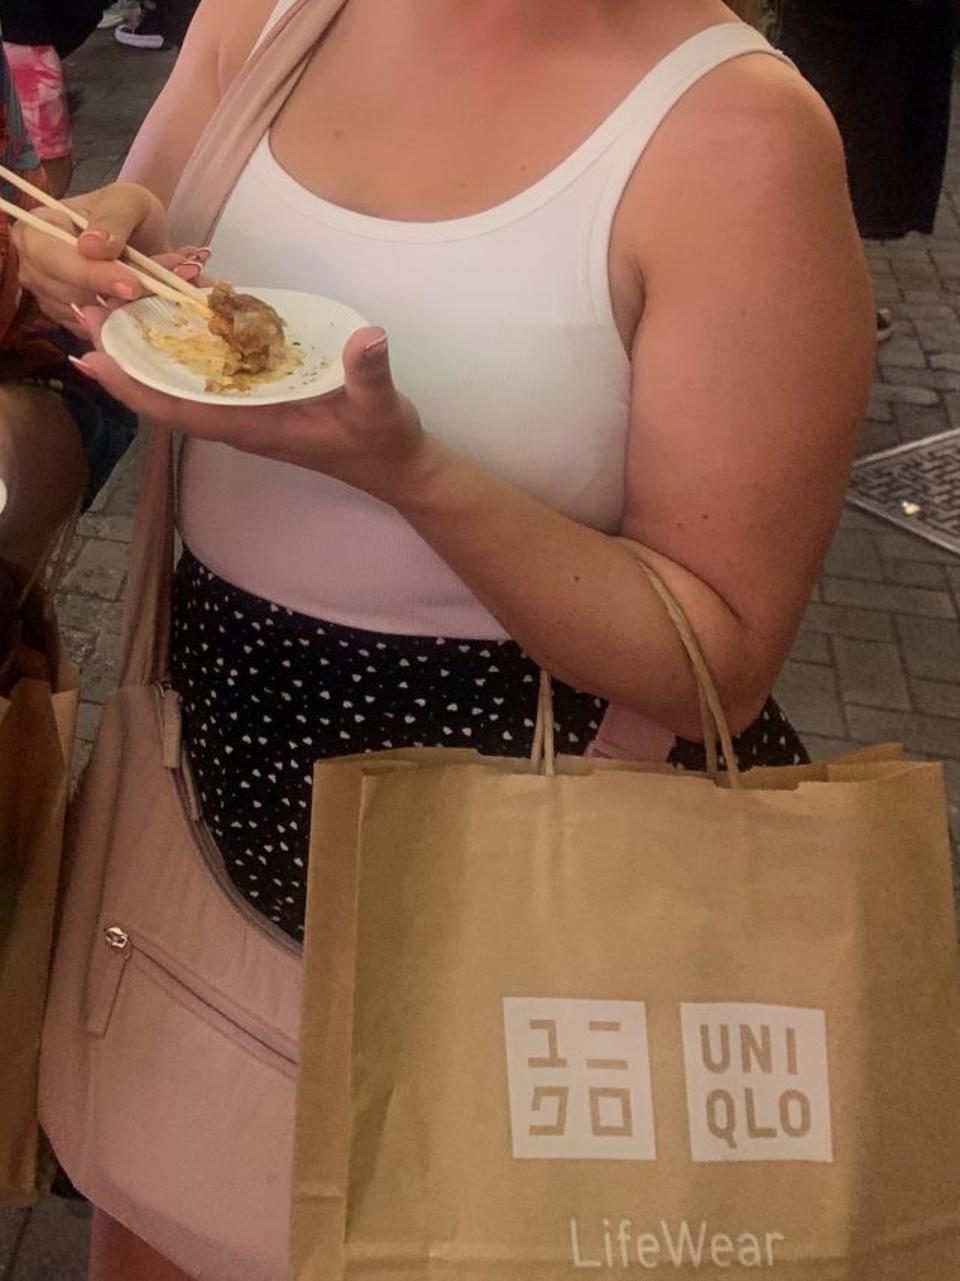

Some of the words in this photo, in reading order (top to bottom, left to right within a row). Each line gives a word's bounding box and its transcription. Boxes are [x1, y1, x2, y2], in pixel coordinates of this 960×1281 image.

[700, 1023, 799, 1075] UNI
[705, 1087, 811, 1149] QLO
[570, 1218, 785, 1269] LifeWear
